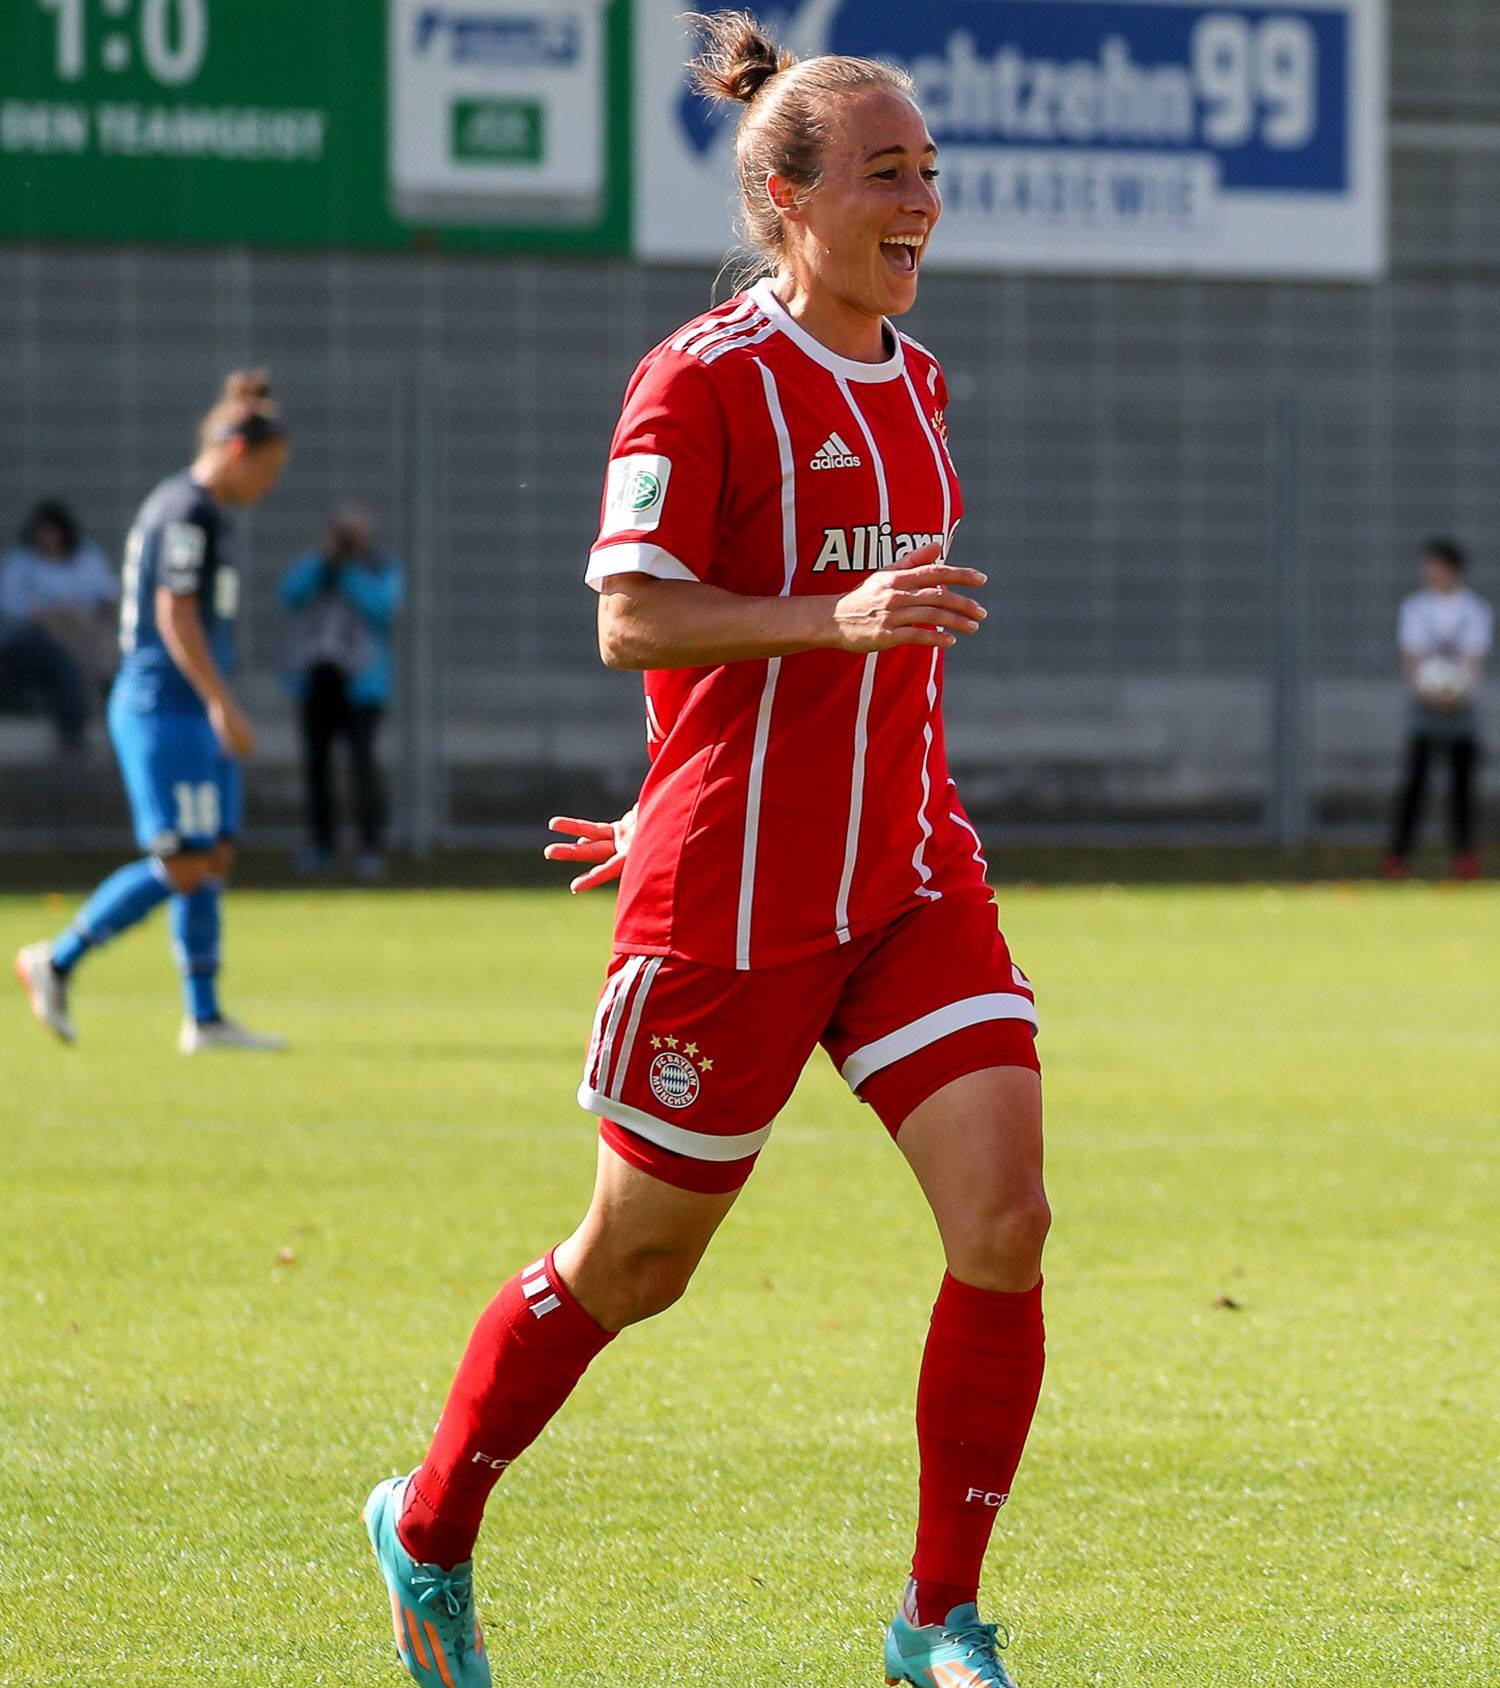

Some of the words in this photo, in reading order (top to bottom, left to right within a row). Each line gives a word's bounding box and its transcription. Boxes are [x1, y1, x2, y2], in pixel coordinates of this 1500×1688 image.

[40, 0, 208, 86] 1:0
[890, 14, 1316, 148] chtzehn99
[810, 455, 861, 470] adidas
[812, 523, 944, 571] Allia
